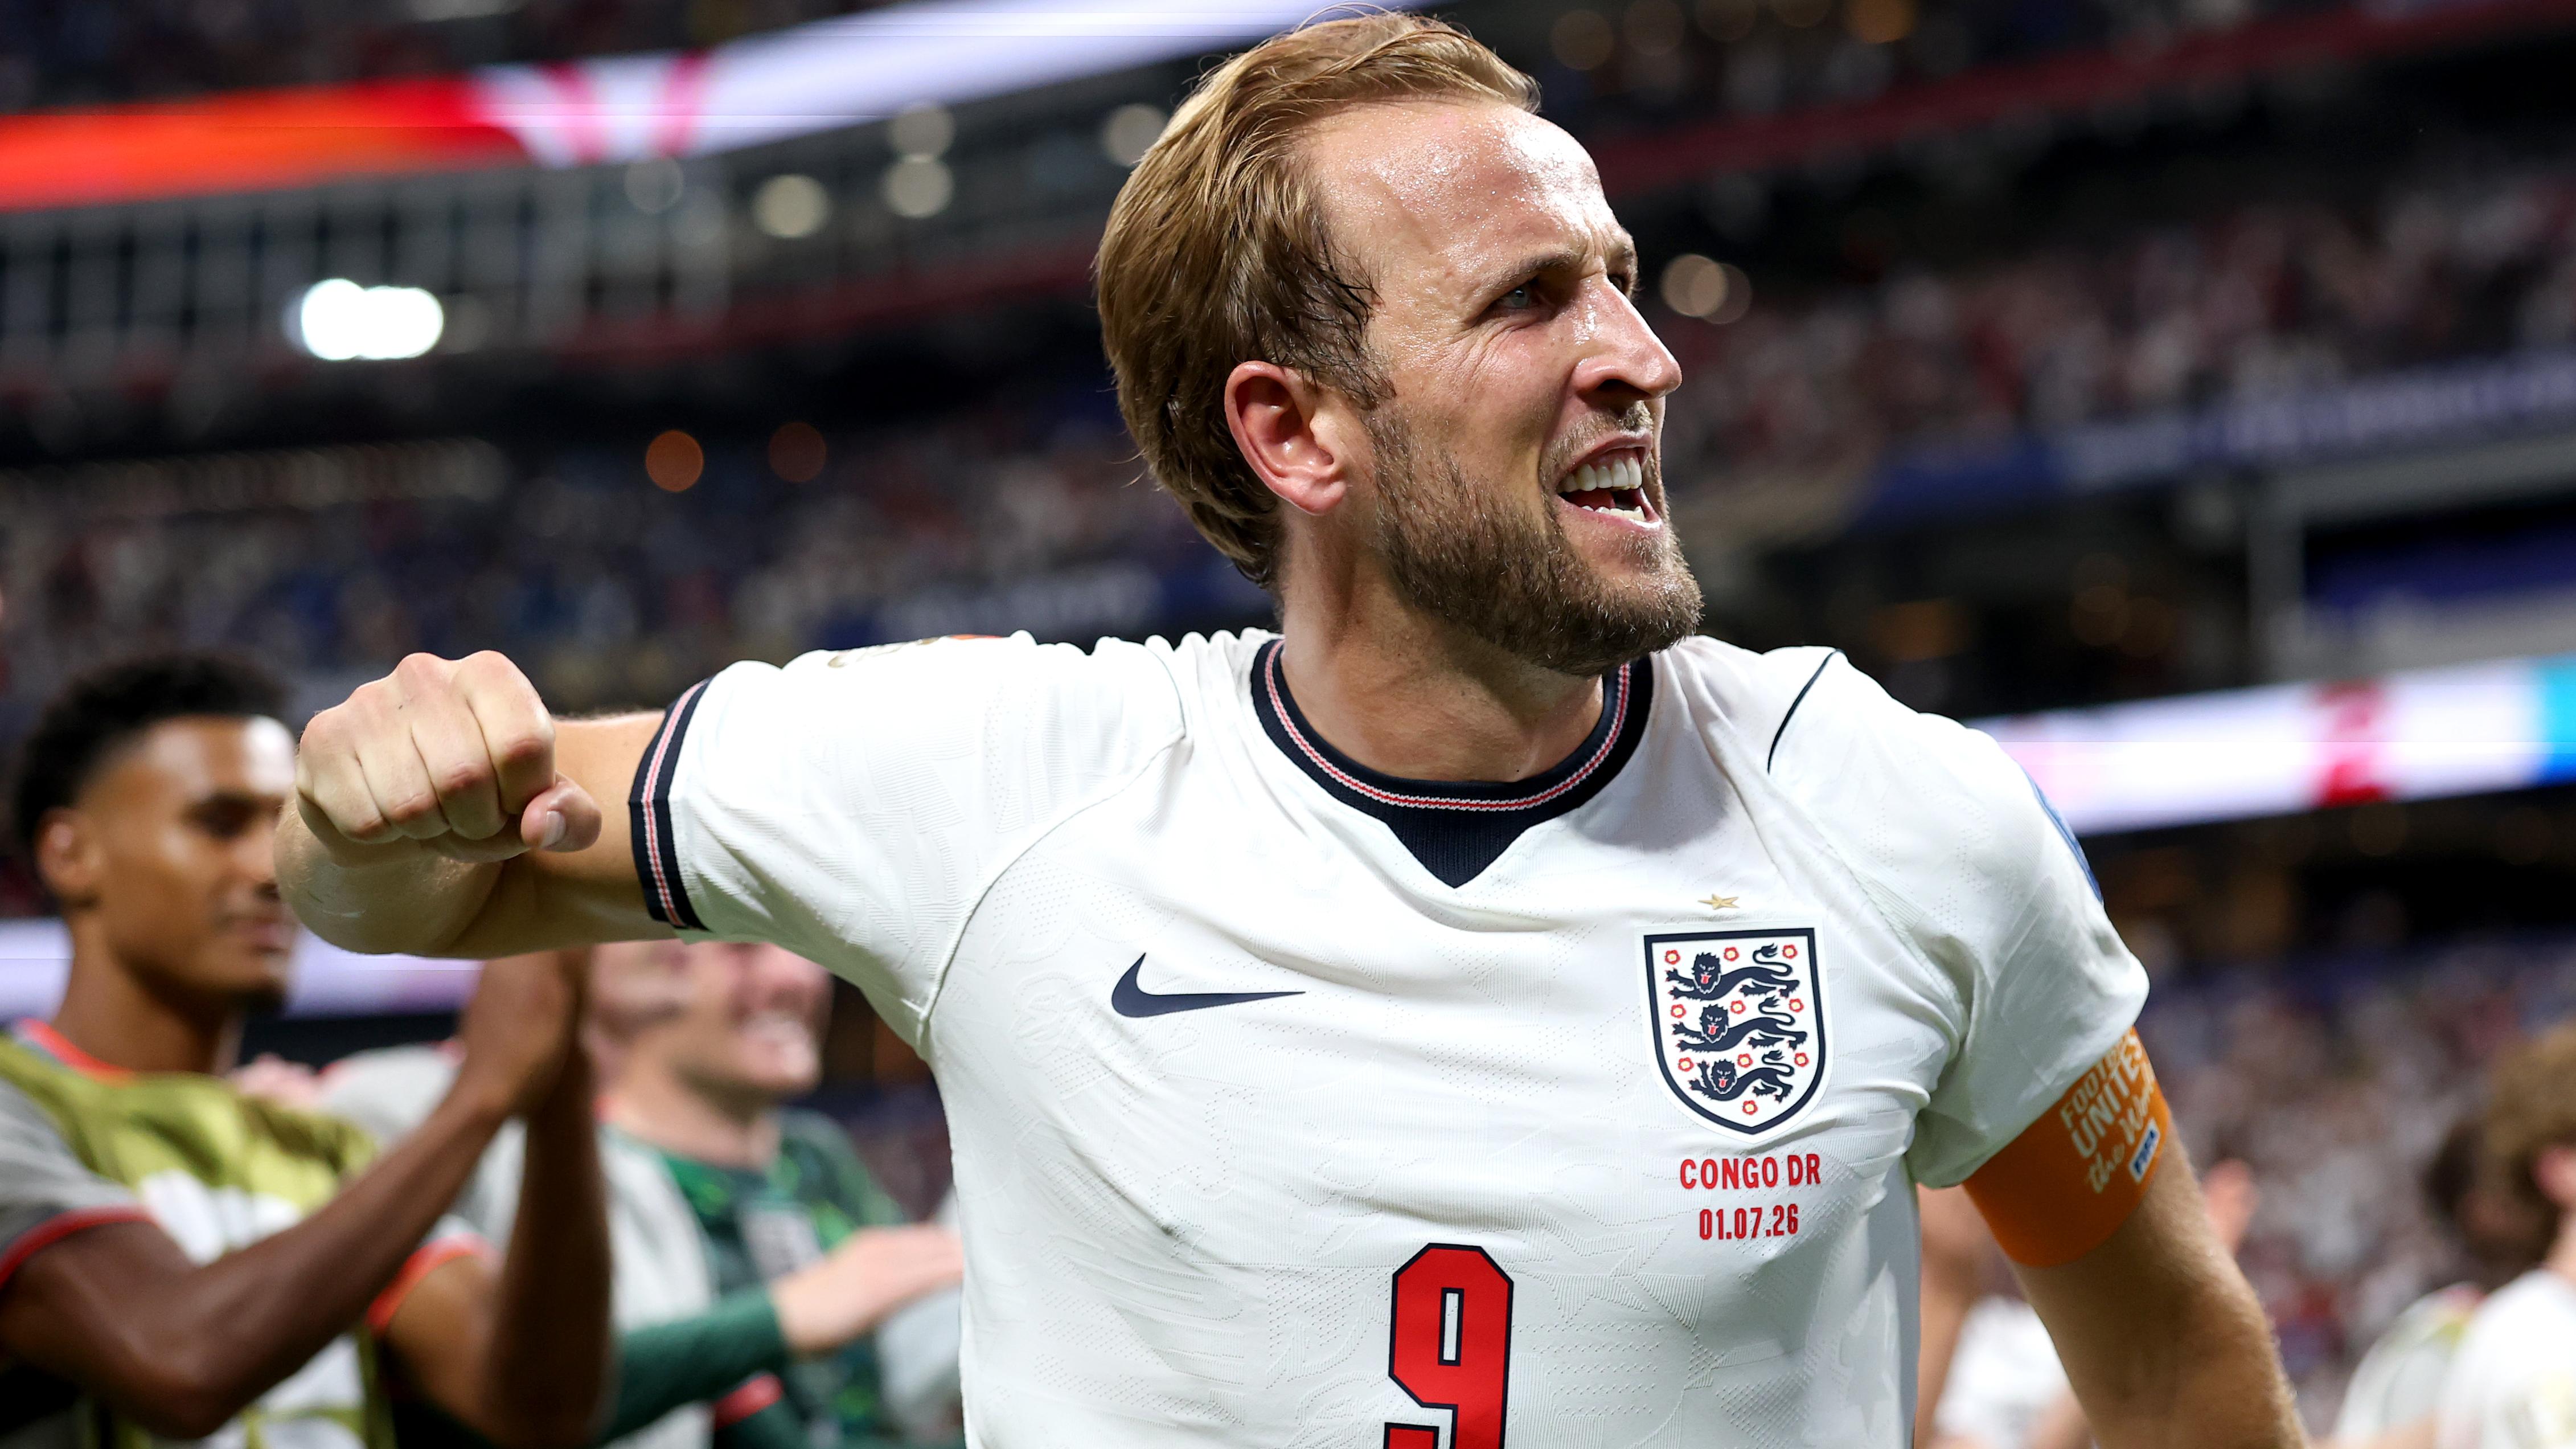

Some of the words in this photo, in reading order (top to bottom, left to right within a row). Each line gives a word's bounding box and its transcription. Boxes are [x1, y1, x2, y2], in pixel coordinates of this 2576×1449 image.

[1680, 1156, 1778, 1189] CONGO
[1787, 1153, 1821, 1186] DR
[1699, 1203, 1798, 1240] 01.07.26
[1383, 1242, 1514, 1449] 9
